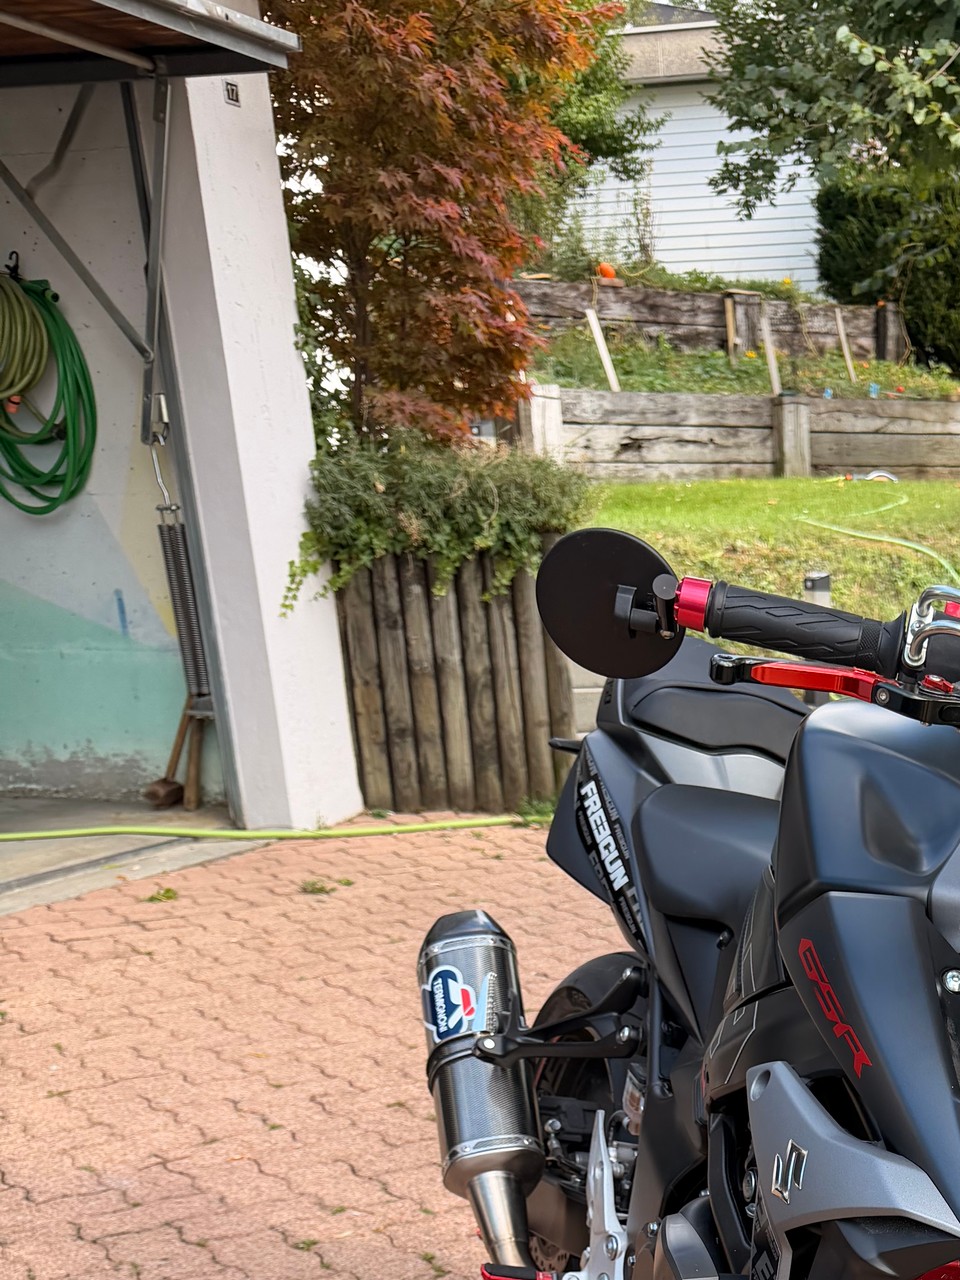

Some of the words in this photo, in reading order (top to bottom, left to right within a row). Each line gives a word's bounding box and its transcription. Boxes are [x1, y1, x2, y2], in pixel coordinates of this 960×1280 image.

[227, 84, 237, 101] 17
[432, 977, 448, 1033] TERMIGNONI
[798, 938, 873, 1079] GSR
